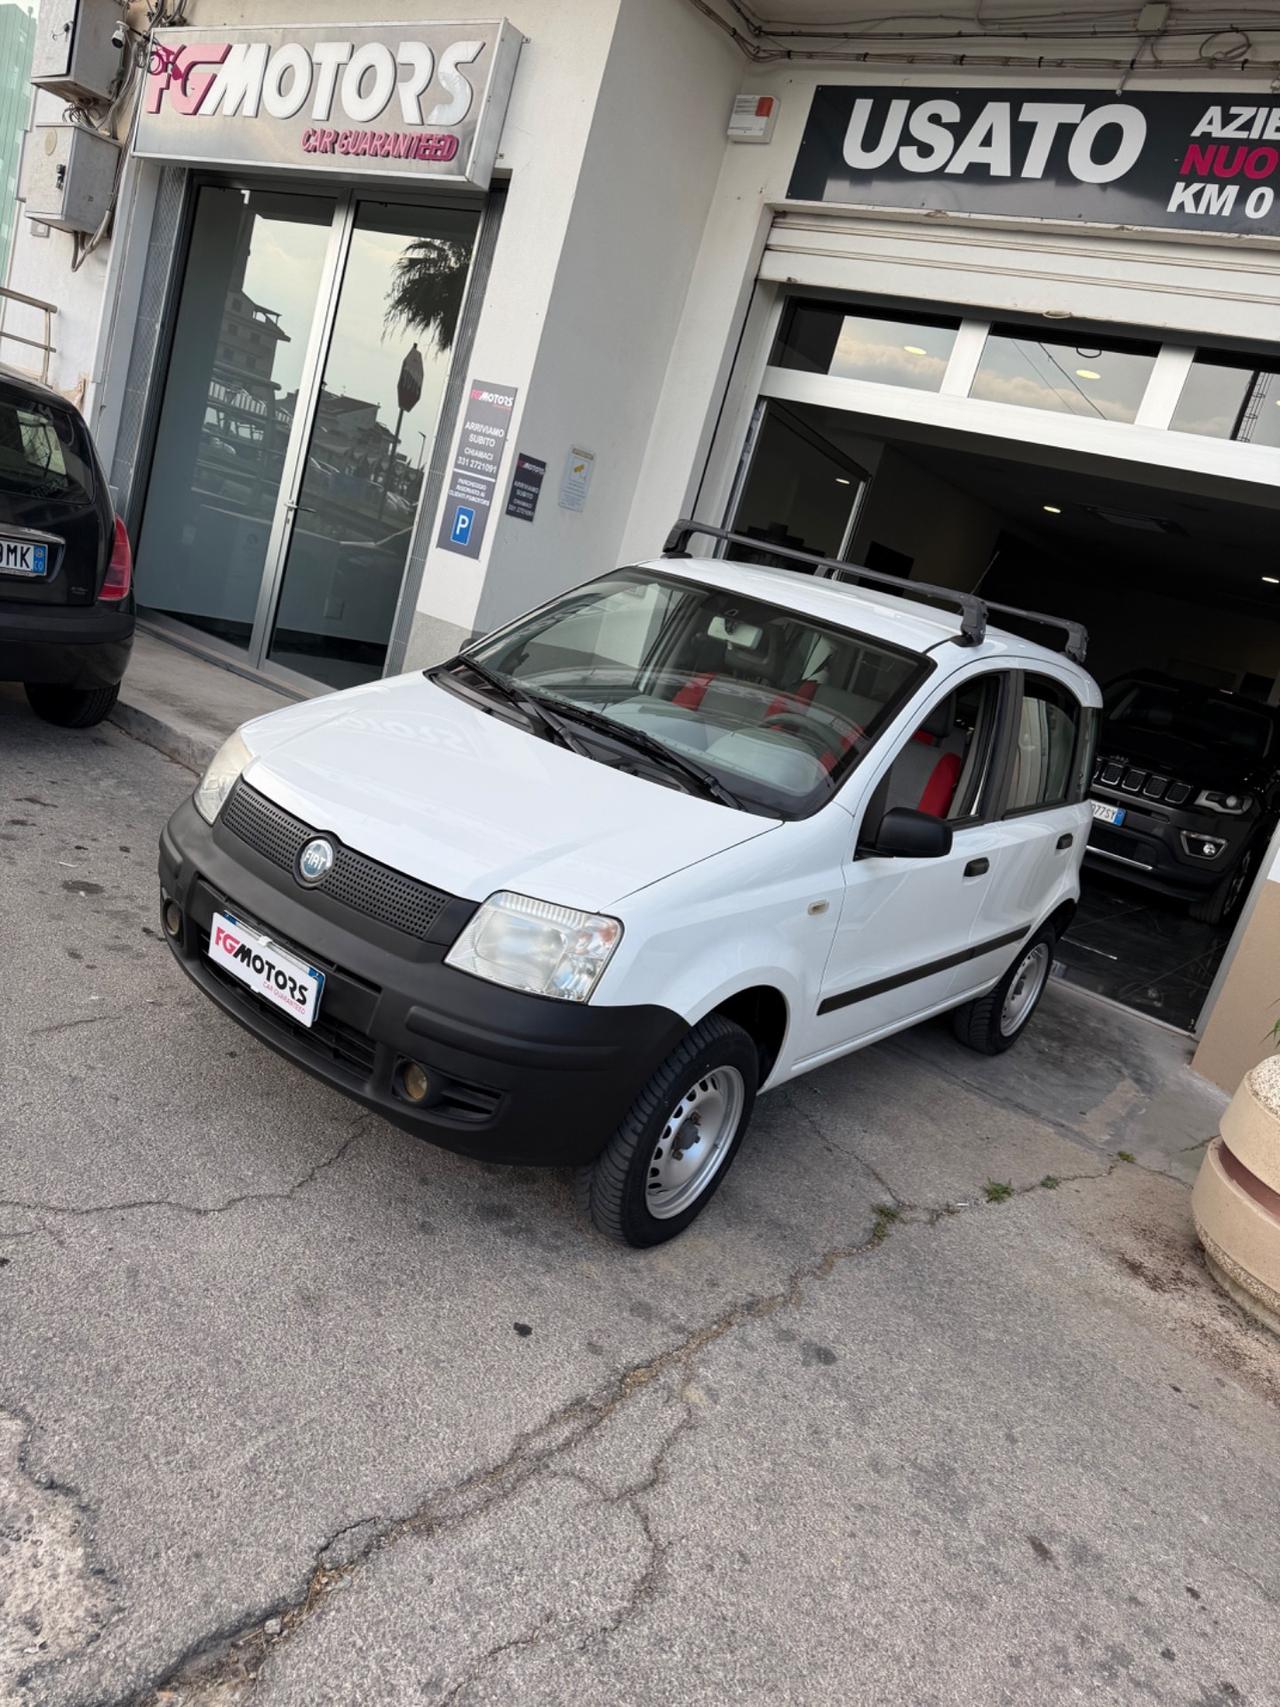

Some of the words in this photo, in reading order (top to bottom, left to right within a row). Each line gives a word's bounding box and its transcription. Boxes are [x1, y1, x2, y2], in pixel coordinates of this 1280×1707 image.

[301, 128, 337, 155] CAR
[337, 130, 459, 162] GUARANTEED
[842, 98, 1147, 184] USATO
[1166, 182, 1240, 216] KM
[1244, 186, 1275, 219] 0
[464, 421, 505, 438] ARRIVIAMO
[469, 433, 496, 447] SUBITO
[464, 447, 494, 460] CHIAMACI
[456, 515, 470, 535] P
[304, 851, 327, 870] FIAT
[215, 926, 309, 1006] FGMOTORS
